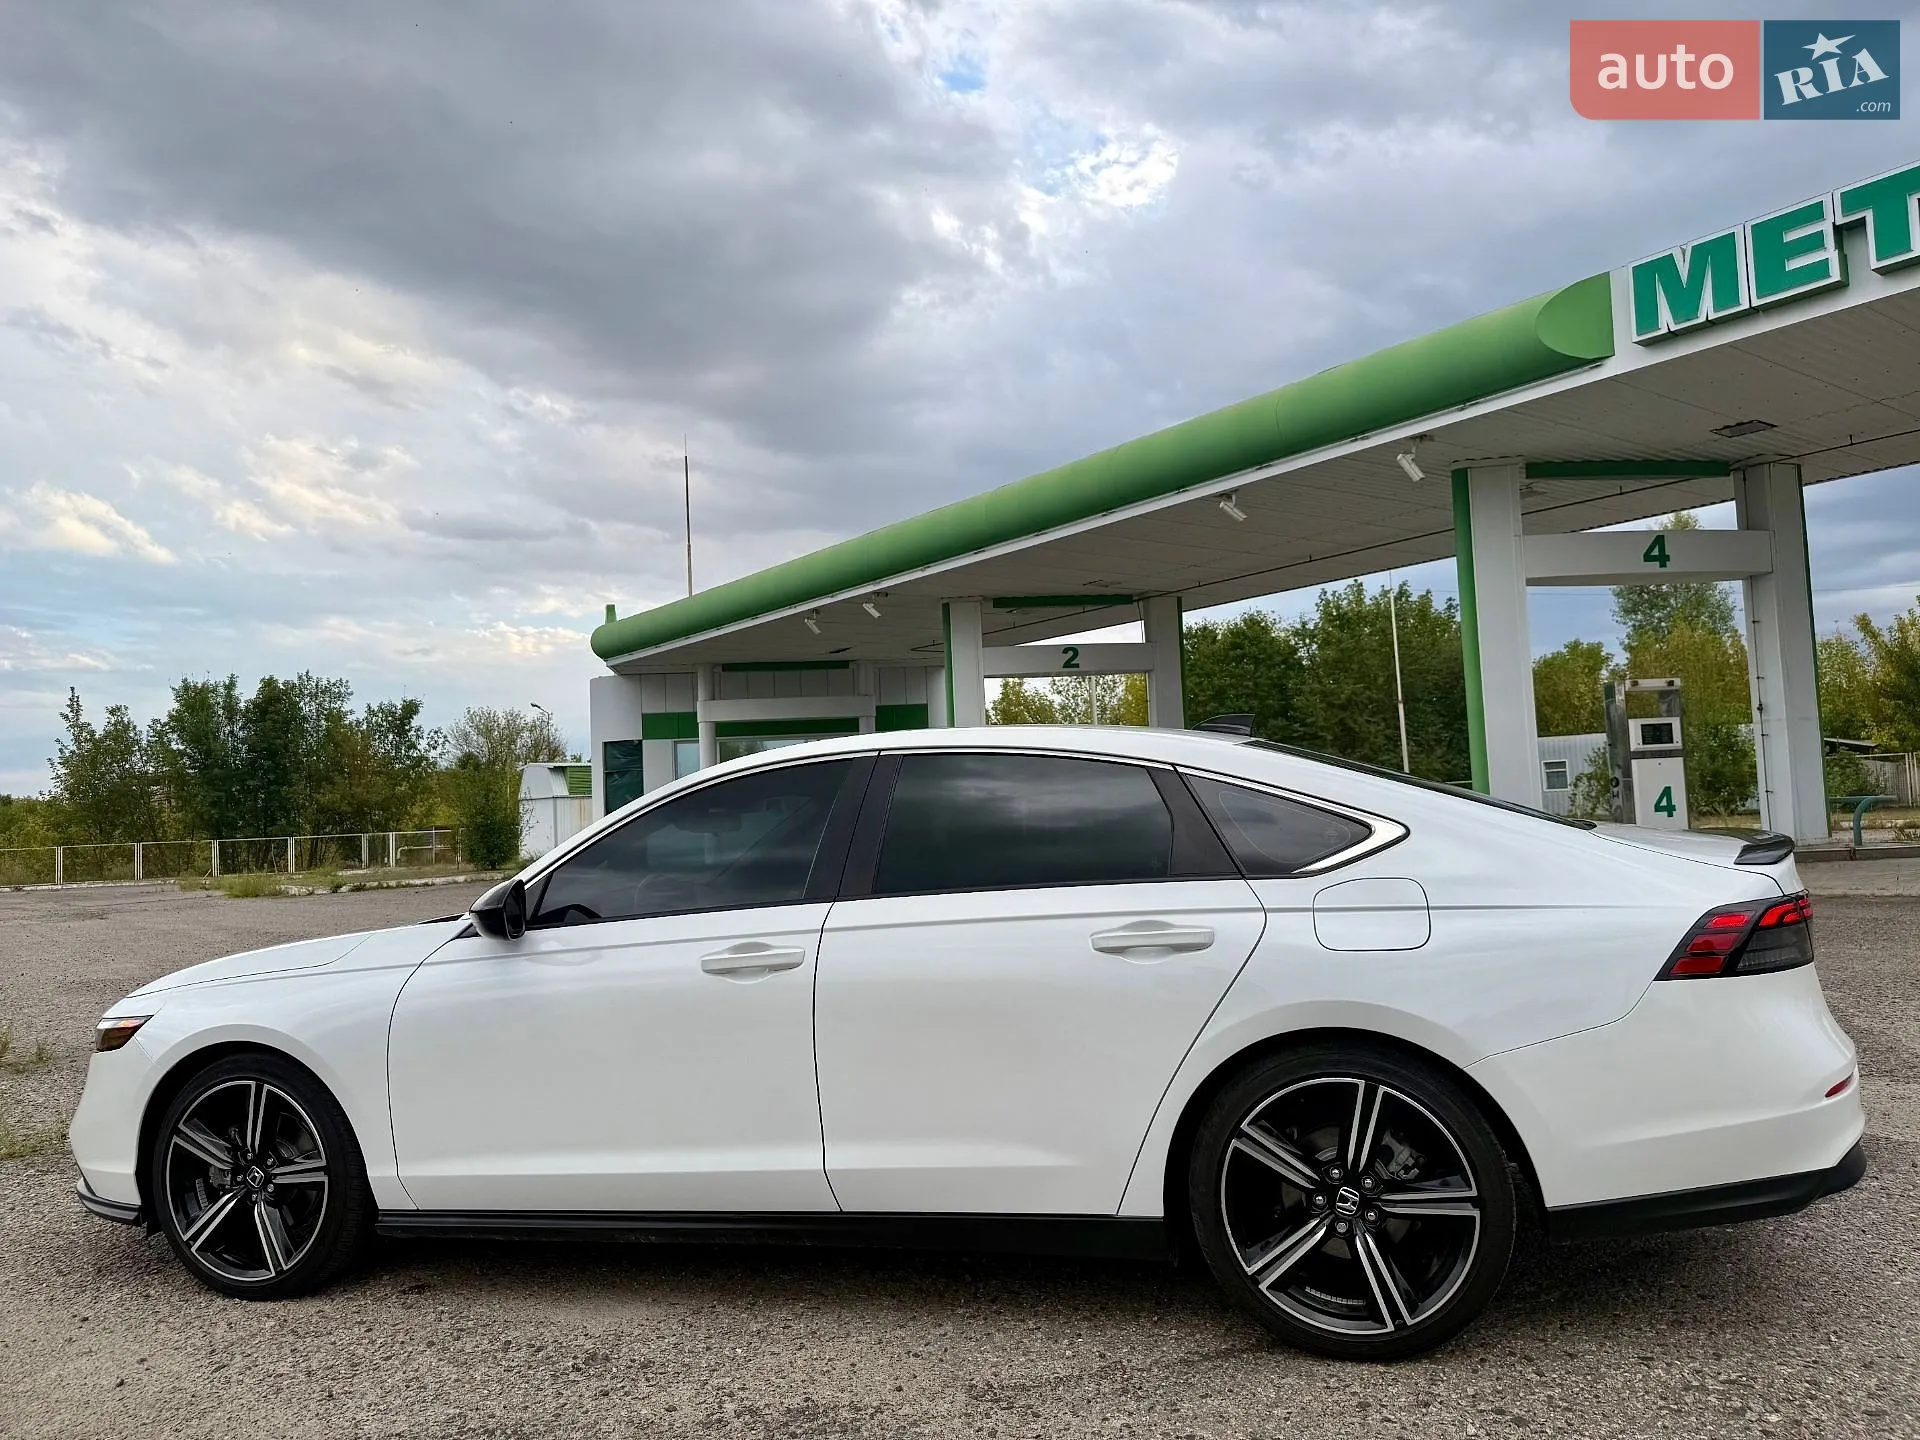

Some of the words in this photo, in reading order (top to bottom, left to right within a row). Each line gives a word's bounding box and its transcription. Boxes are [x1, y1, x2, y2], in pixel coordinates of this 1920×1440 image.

[1643, 535, 1670, 568] 4
[1062, 647, 1080, 668] 2
[1654, 786, 1676, 817] 4
